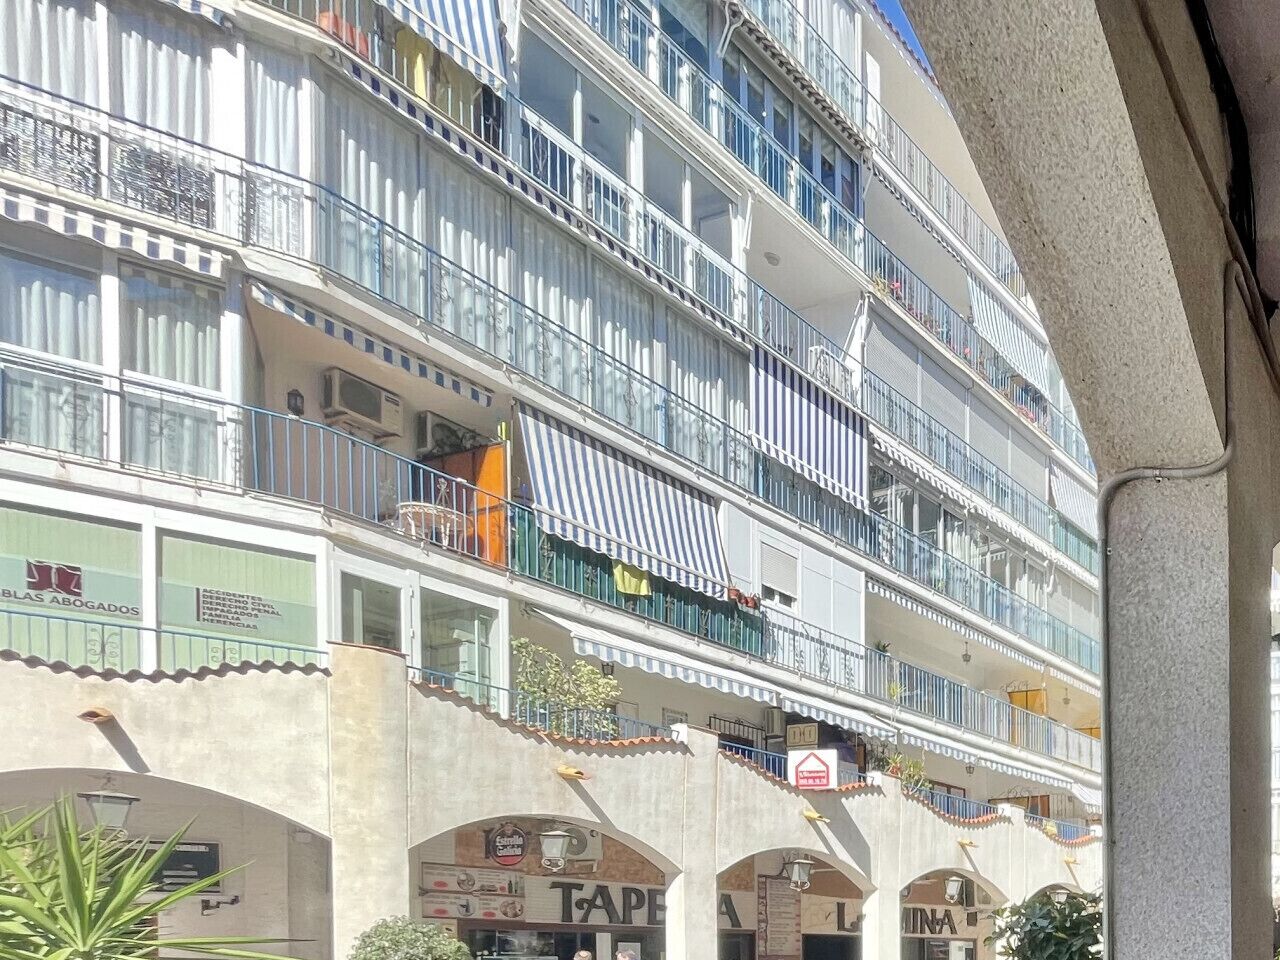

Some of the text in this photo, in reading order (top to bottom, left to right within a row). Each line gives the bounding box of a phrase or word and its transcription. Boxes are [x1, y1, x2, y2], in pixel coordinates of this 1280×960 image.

[202, 588, 263, 602] ACCIDENTES
[49, 596, 140, 616] ABOGADOS
[202, 594, 275, 610] DERECHO CIVIL
[202, 600, 282, 617] DERECHO PENAL
[202, 606, 259, 618] IMPAGADOS
[202, 612, 241, 621] FAMILIA
[202, 618, 258, 630] HERENCIAS
[496, 835, 524, 846] Estrella
[496, 845, 522, 856] Galicia
